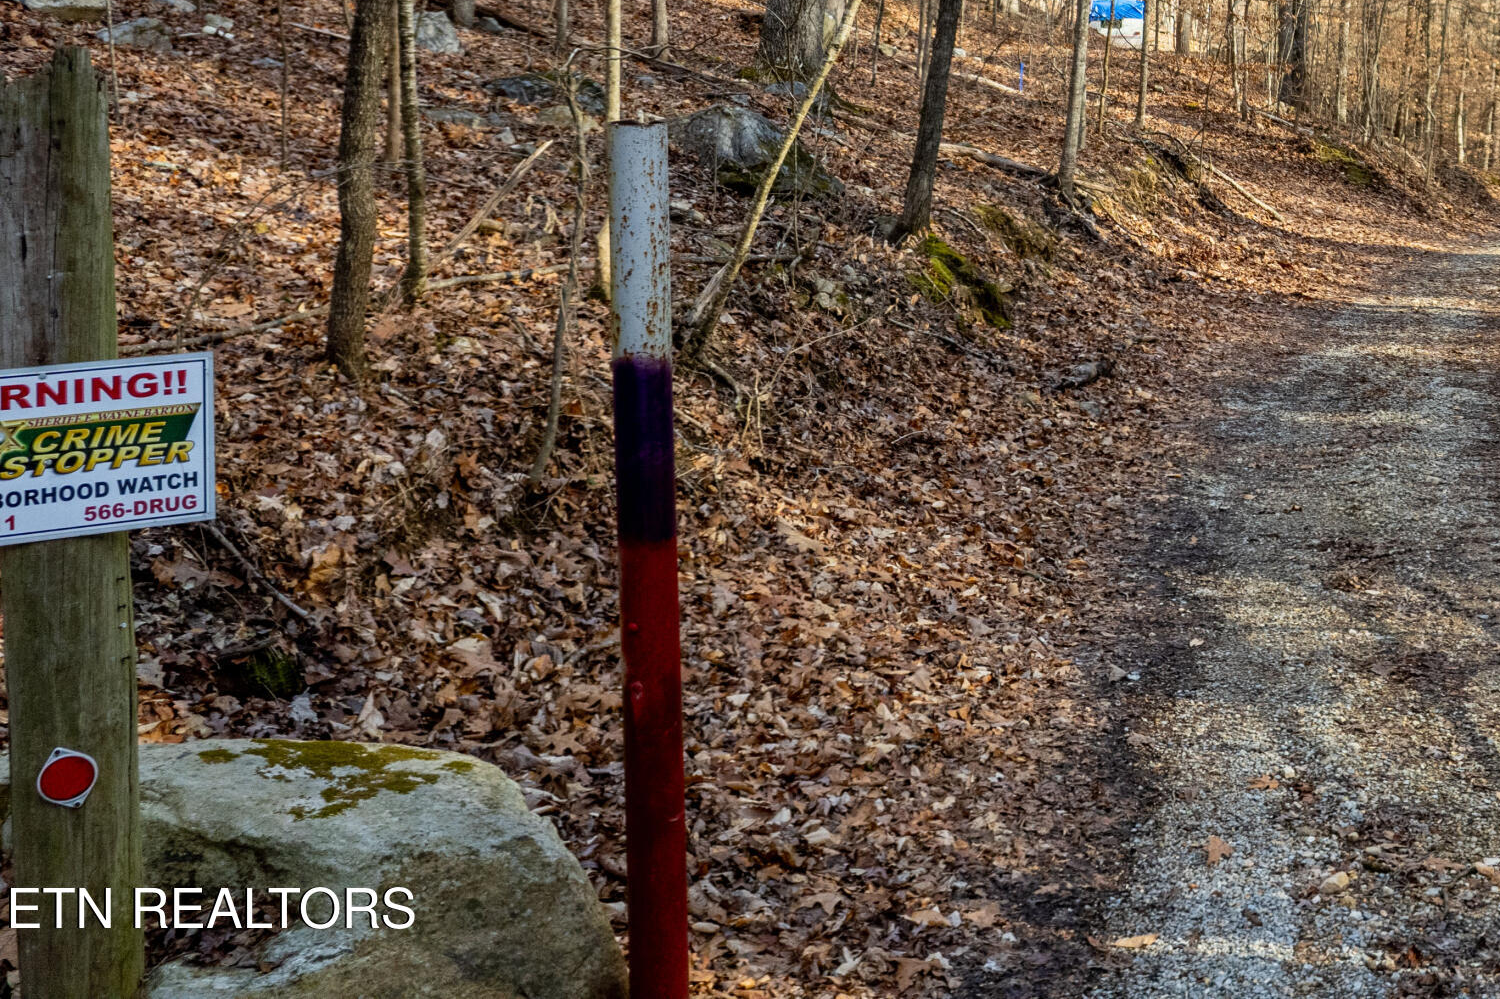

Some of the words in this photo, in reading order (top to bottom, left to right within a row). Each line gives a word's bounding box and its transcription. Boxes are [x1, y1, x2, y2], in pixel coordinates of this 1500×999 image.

[0, 369, 187, 411] RNING!!
[27, 413, 82, 428] SHERIFF
[98, 409, 141, 421] WAYNE
[143, 405, 194, 417] BARTON
[33, 421, 166, 454] CRIME
[0, 439, 194, 480] STOPPER
[0, 481, 110, 509] ORHOOD
[117, 471, 198, 495] WATCH
[84, 494, 197, 521] 566-DRUG
